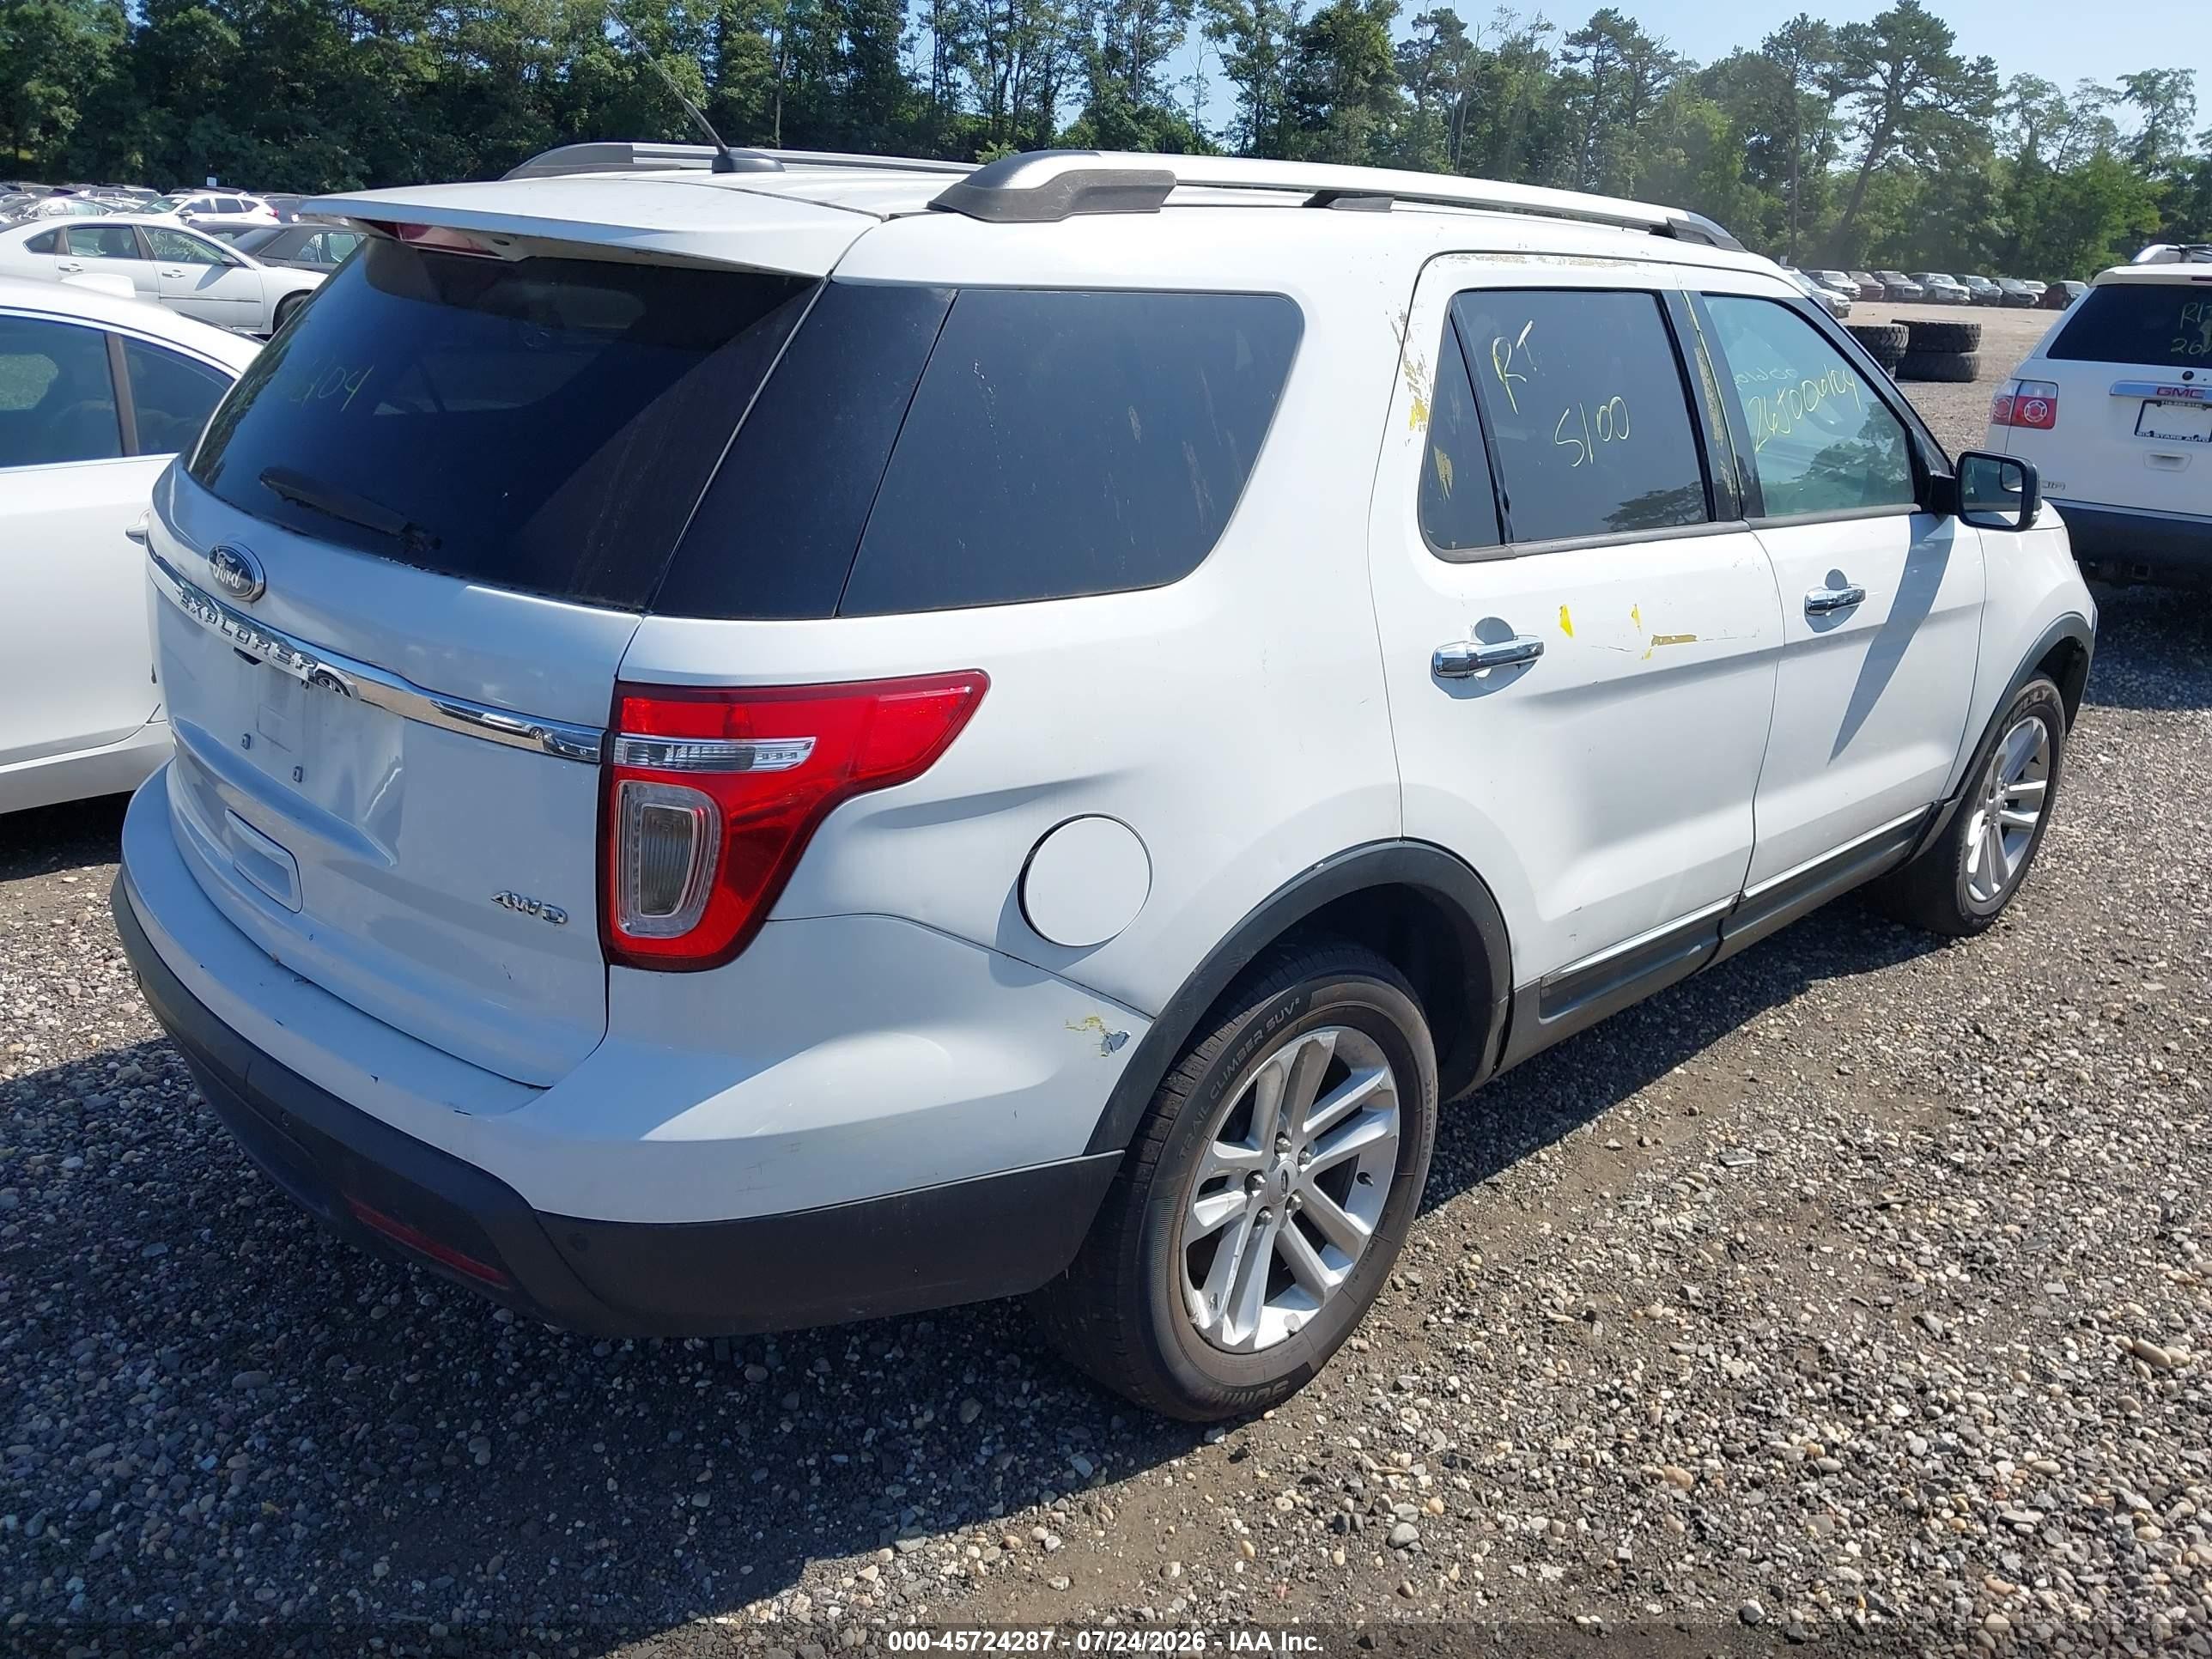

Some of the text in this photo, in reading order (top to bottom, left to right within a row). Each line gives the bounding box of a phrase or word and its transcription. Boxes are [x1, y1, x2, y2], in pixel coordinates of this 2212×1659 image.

[2156, 386, 2206, 398] GMC
[212, 544, 243, 590] Ford
[173, 584, 319, 683] EXPLORER
[1179, 1105, 1210, 1159] TRAIL
[1210, 1030, 1265, 1100] CLIMBER
